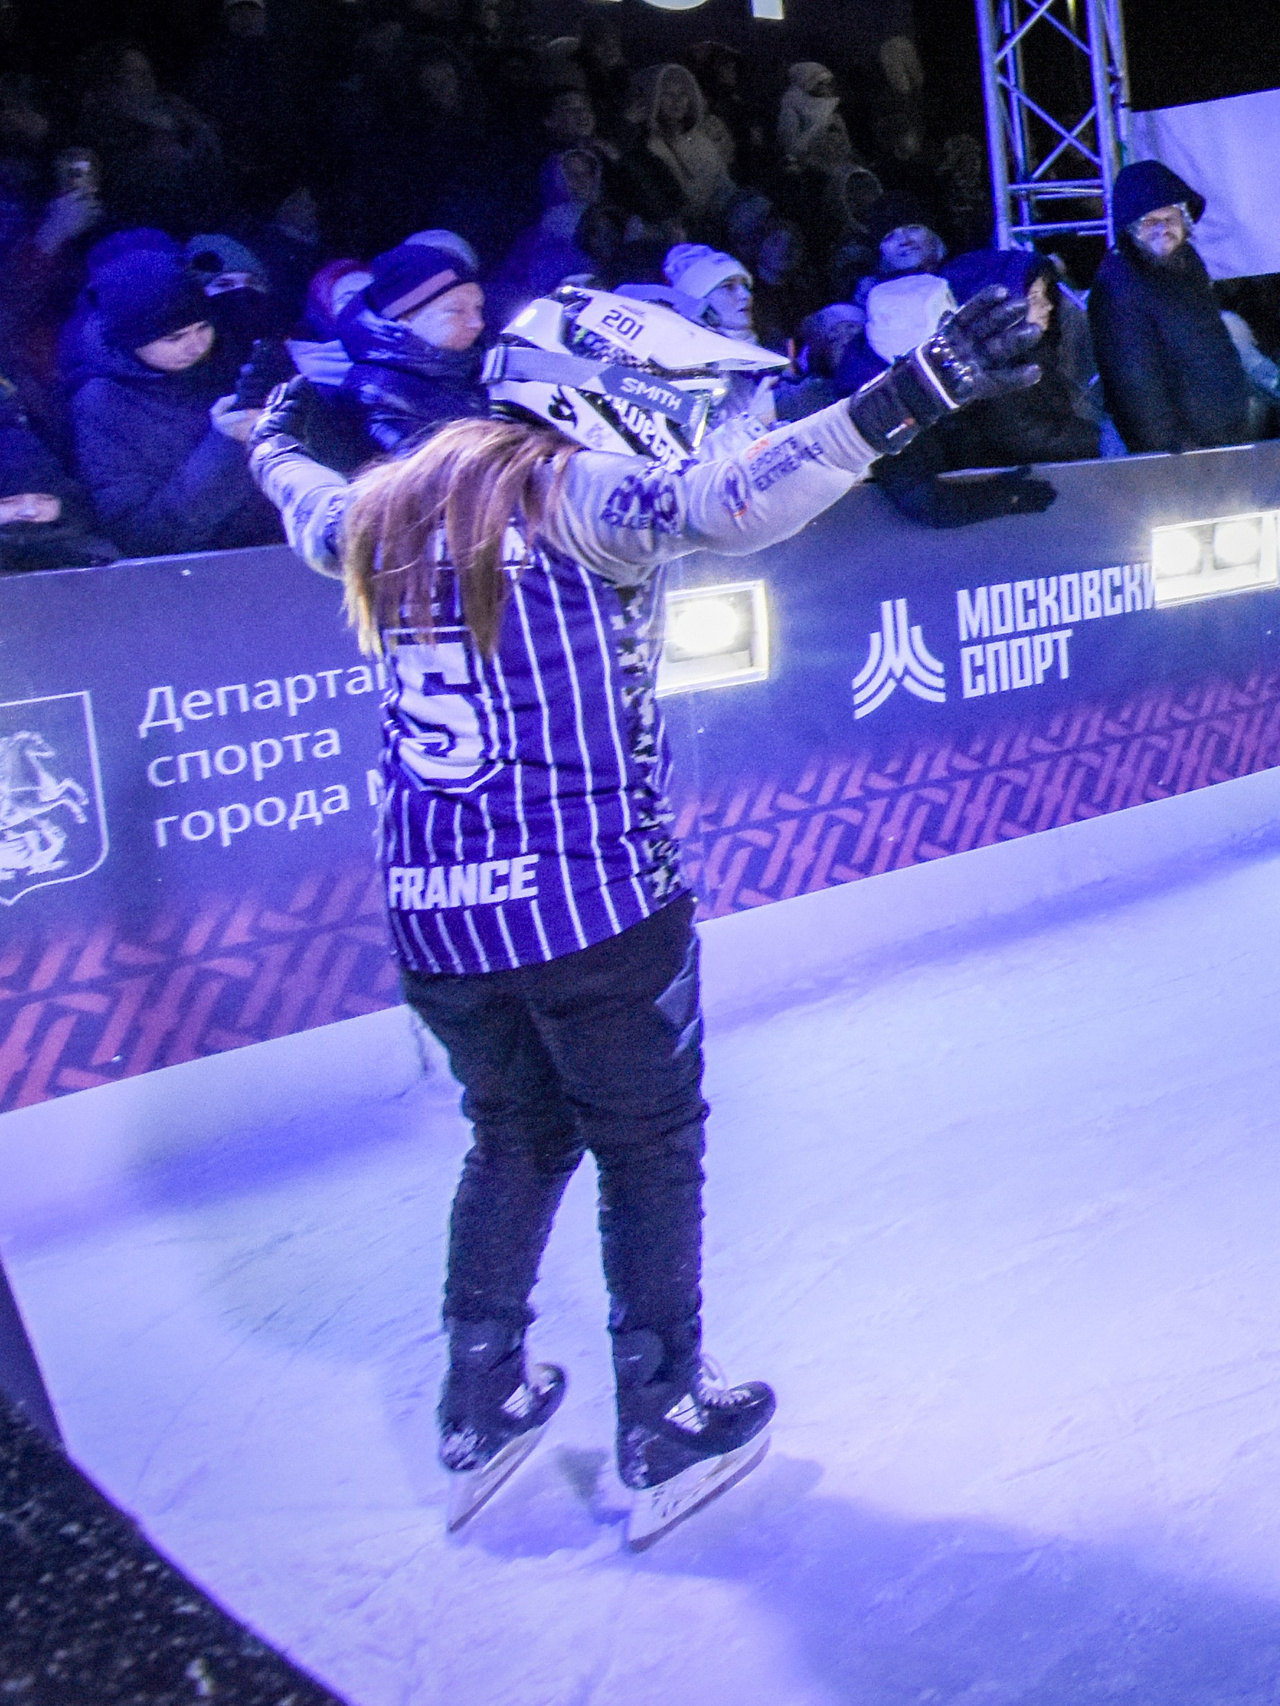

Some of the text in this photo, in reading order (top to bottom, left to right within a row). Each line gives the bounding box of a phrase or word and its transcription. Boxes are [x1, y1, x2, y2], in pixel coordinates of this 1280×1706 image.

[601, 308, 645, 341] 201
[620, 375, 683, 412] SMITH
[956, 562, 1155, 641] МОСКОВСКИ
[961, 628, 1073, 699] СПОРТ
[388, 632, 498, 789] 5
[147, 727, 342, 788] спорта
[154, 783, 350, 848] города
[388, 854, 540, 910] FRANCE
